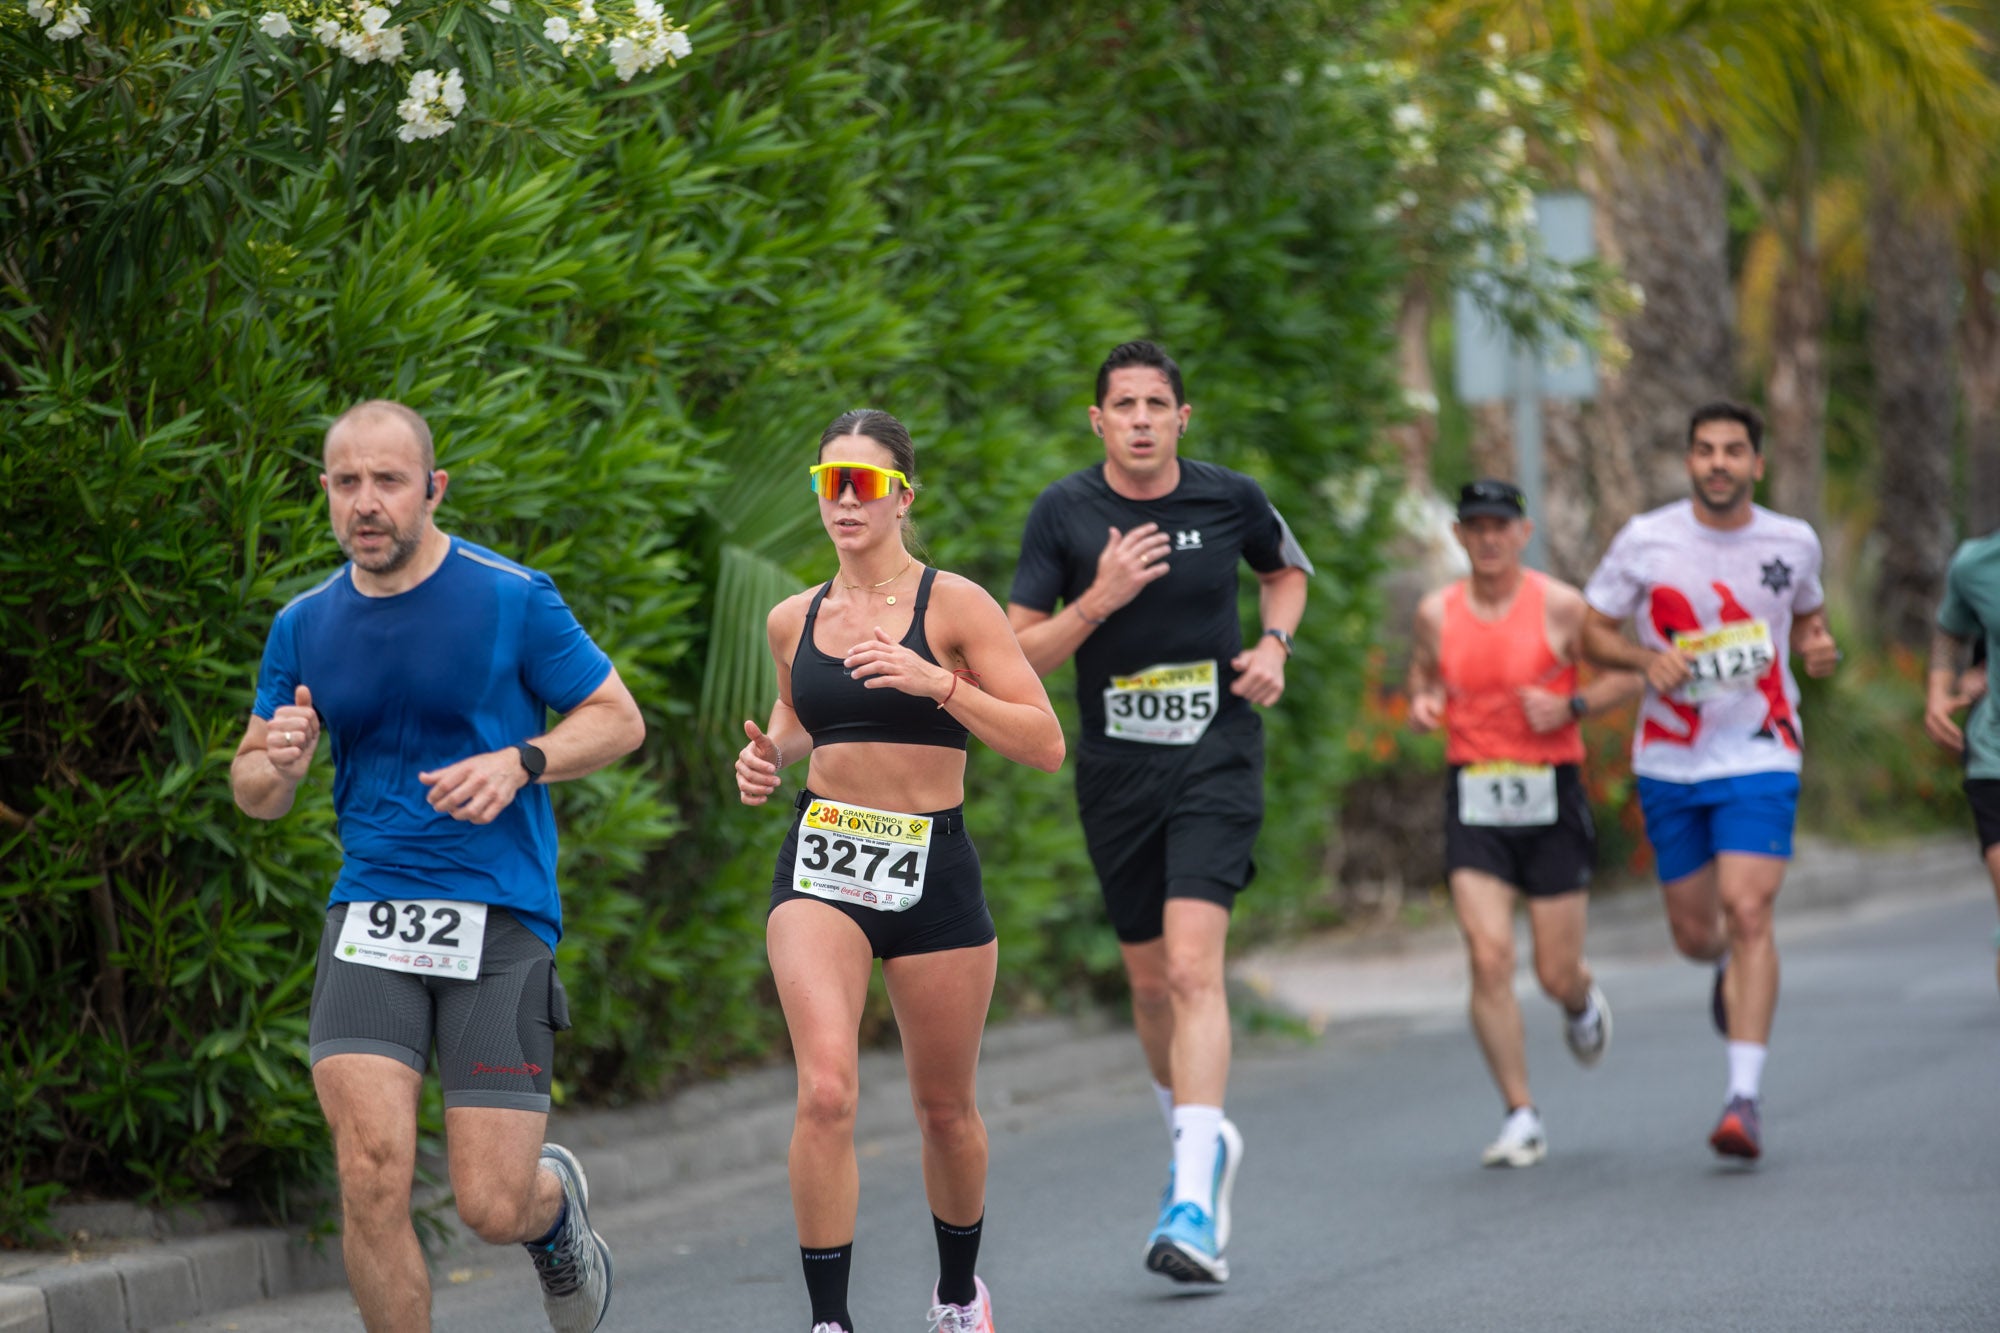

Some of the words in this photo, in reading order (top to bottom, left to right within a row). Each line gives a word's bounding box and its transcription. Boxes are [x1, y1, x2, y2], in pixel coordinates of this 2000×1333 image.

[1111, 692, 1211, 721] 3085
[1490, 778, 1529, 806] 13
[820, 807, 839, 824] 38
[843, 809, 865, 819] GRAN
[866, 813, 897, 825] PREMIO
[838, 815, 902, 837] FONDO
[802, 833, 920, 888] 3274
[367, 902, 462, 948] 932
